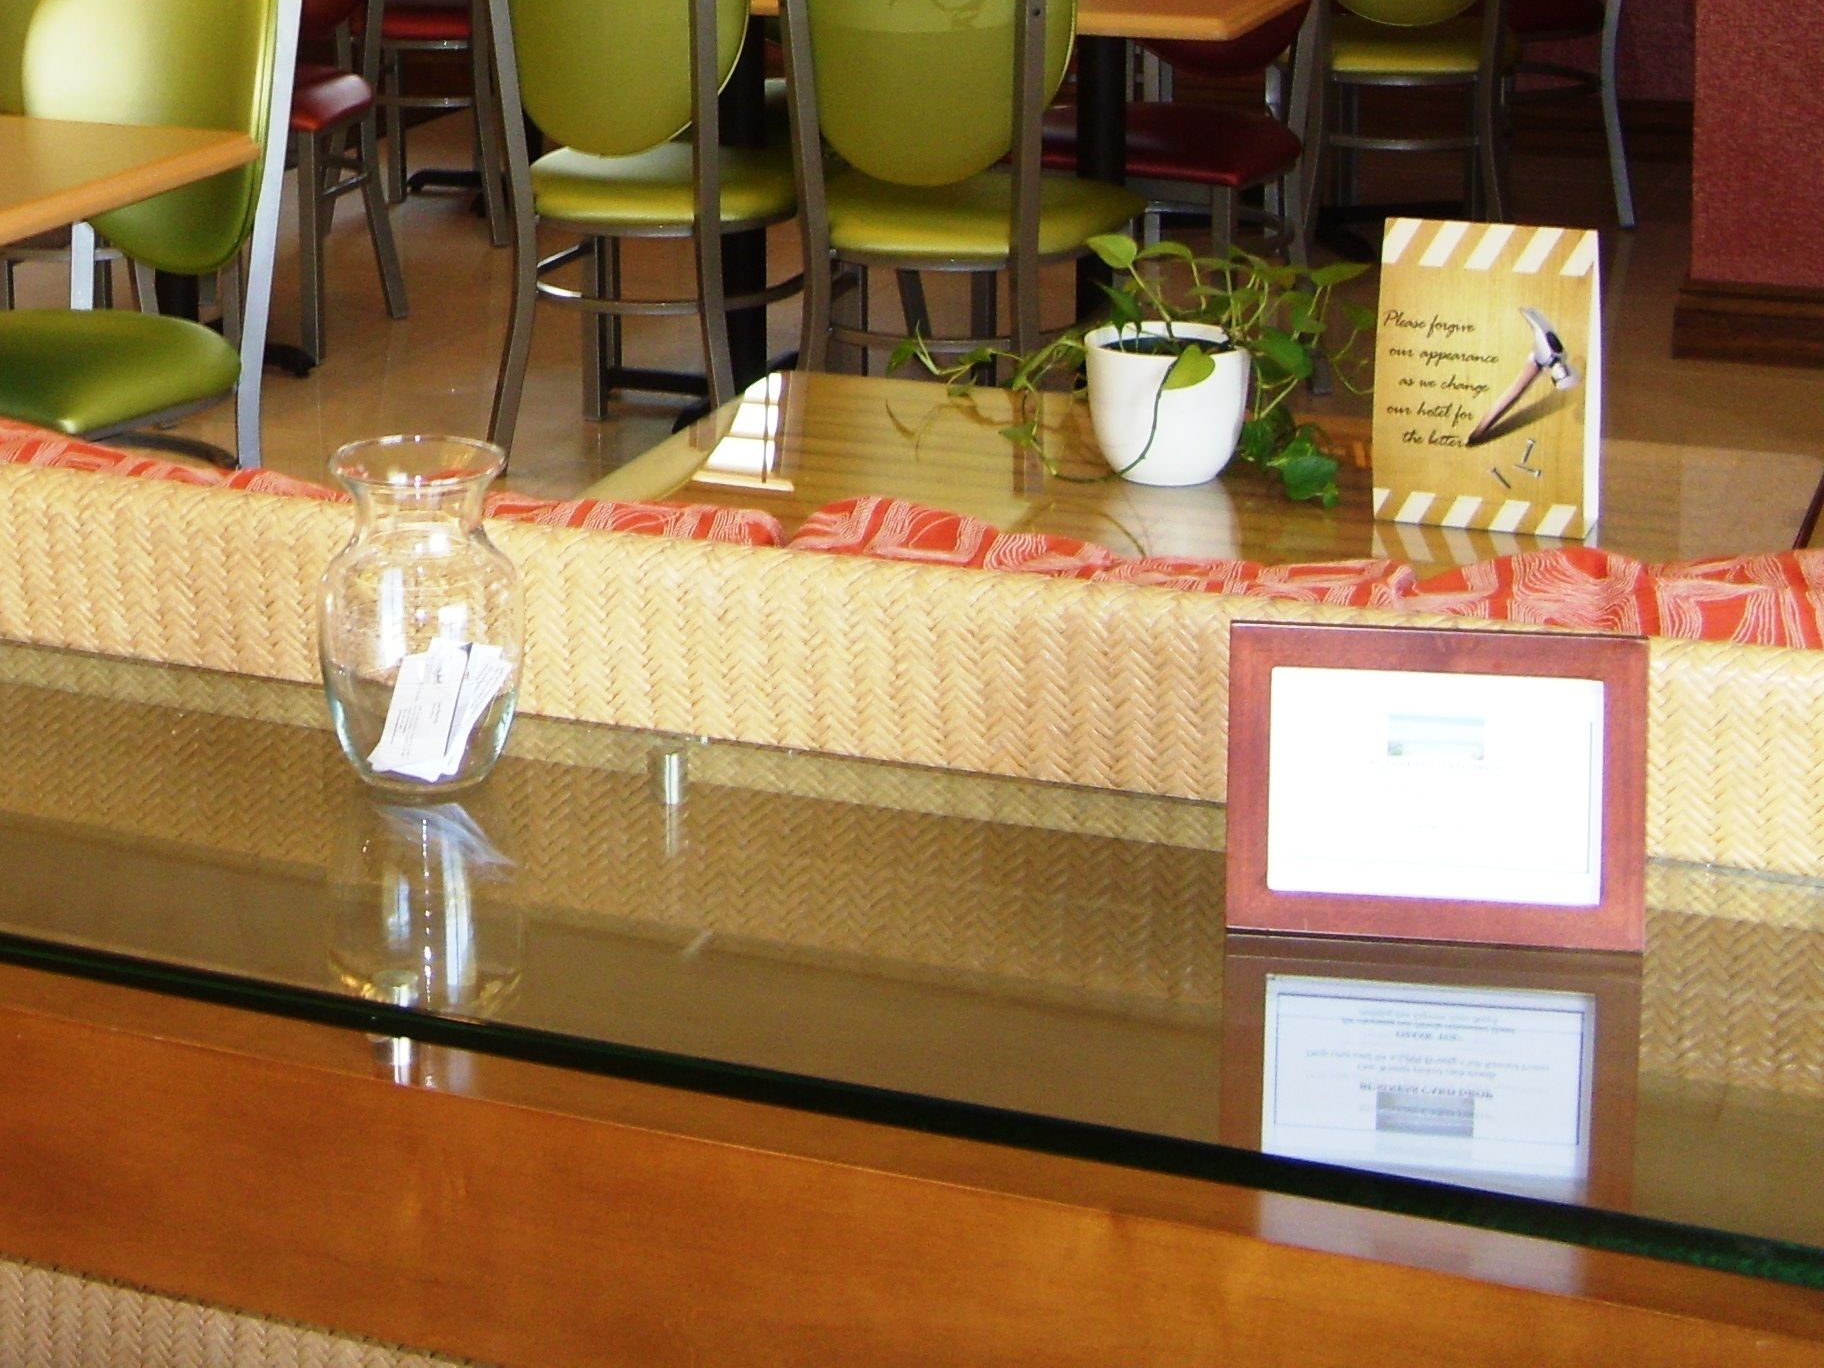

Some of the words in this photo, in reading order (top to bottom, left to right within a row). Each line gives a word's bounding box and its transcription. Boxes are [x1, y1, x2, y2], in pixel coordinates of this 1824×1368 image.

[1382, 309, 1426, 328] Please
[1425, 313, 1476, 339] forgive
[1388, 347, 1415, 358] our
[1419, 349, 1500, 368] appearance
[1398, 377, 1415, 388] as
[1419, 379, 1437, 389] we
[1440, 374, 1491, 399] change
[1386, 405, 1412, 416] our
[1416, 401, 1454, 419] hotel
[1451, 404, 1475, 429] for
[1401, 430, 1424, 444] the
[1427, 430, 1465, 448] better
